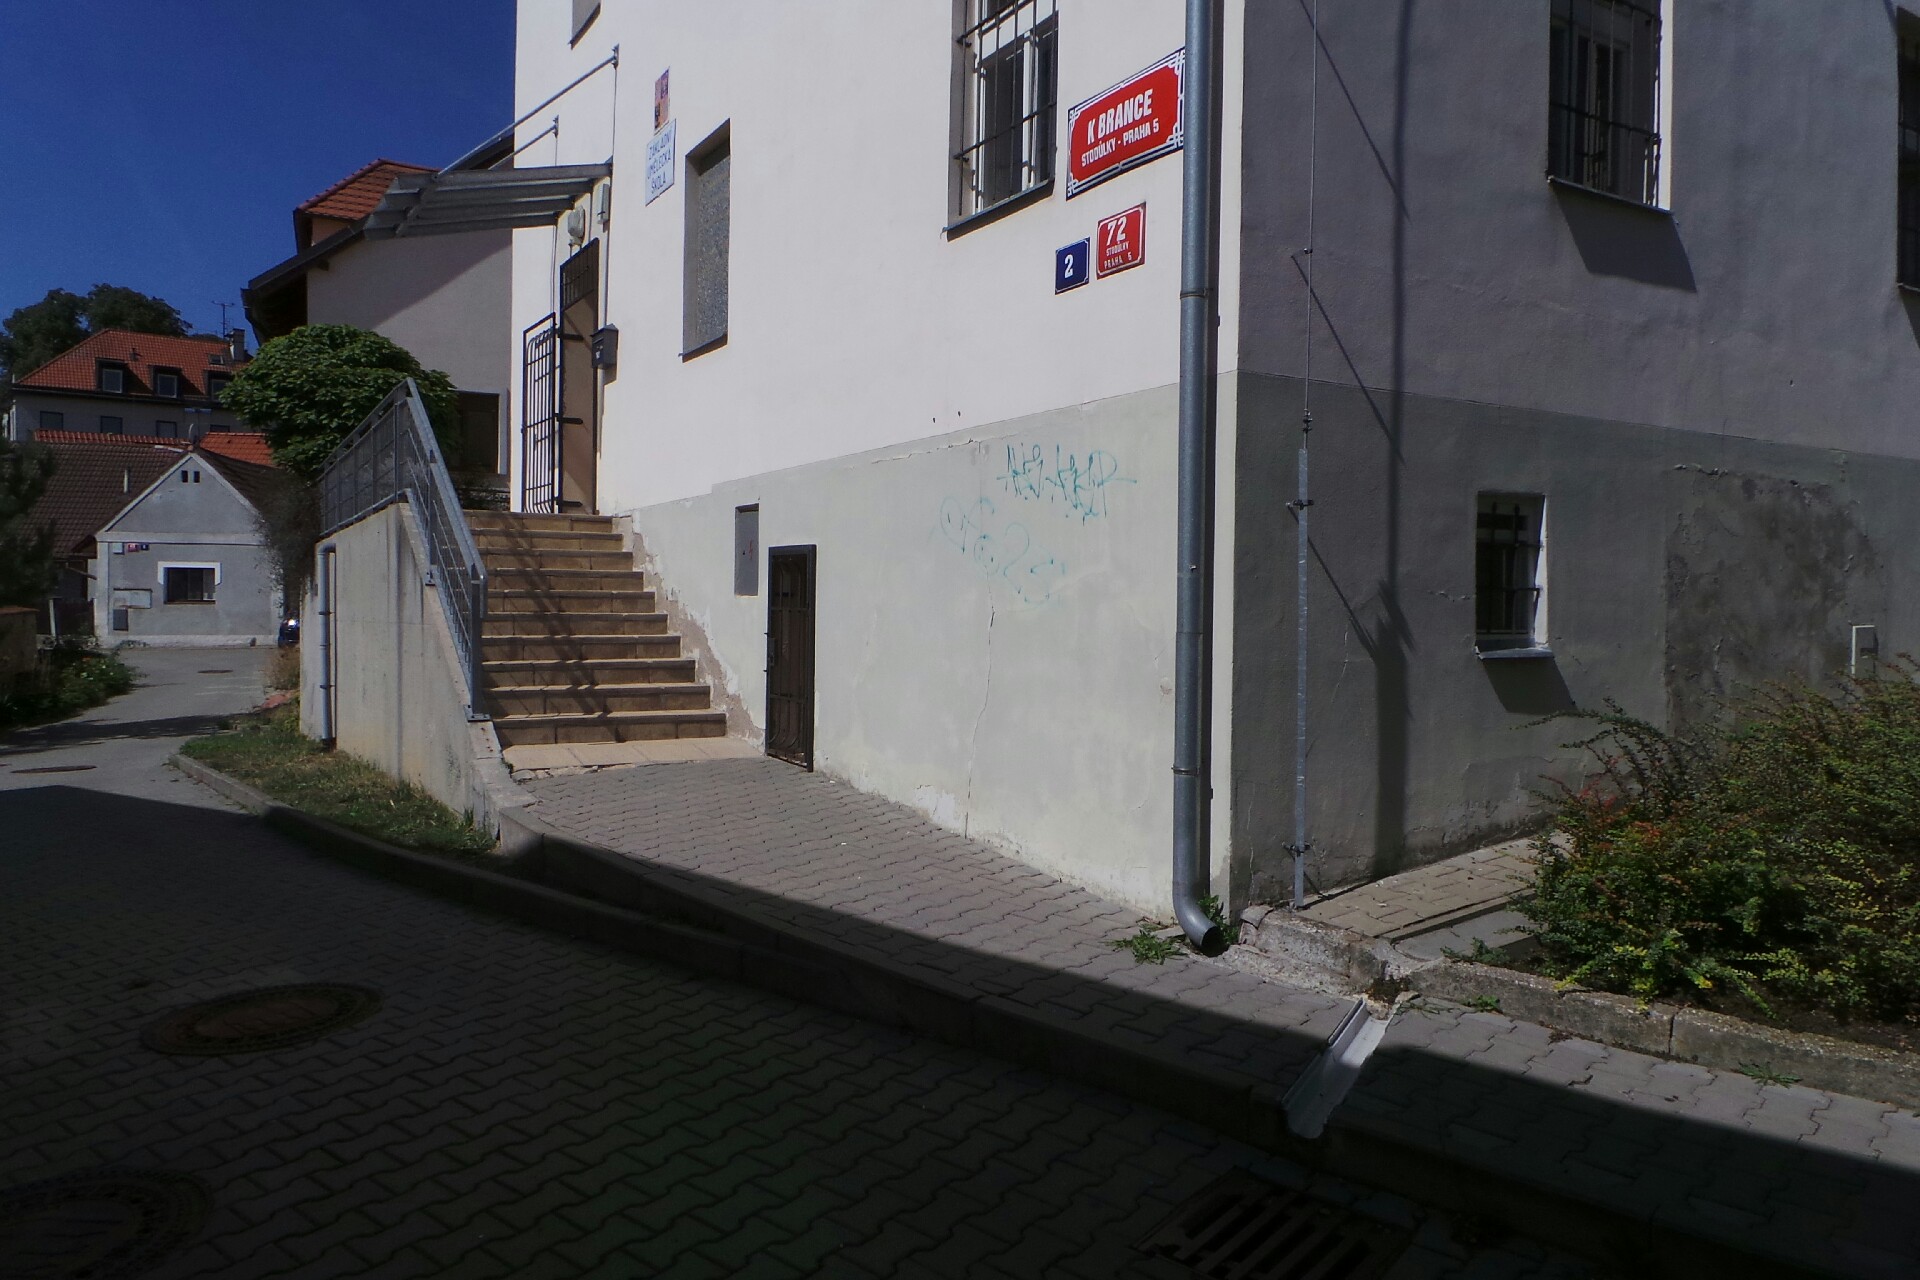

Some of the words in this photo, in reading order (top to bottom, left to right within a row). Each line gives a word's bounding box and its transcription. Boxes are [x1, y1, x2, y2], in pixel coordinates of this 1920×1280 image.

[1087, 118, 1095, 145] K
[1097, 88, 1154, 139] BRANCE
[1081, 137, 1117, 168] STODŮLKY
[1122, 122, 1151, 147] PRAHA
[1153, 118, 1159, 133] 5
[1106, 216, 1127, 246] 72
[1064, 255, 1074, 278] 2
[1103, 255, 1124, 270] PRAHA
[1127, 251, 1132, 261] 5
